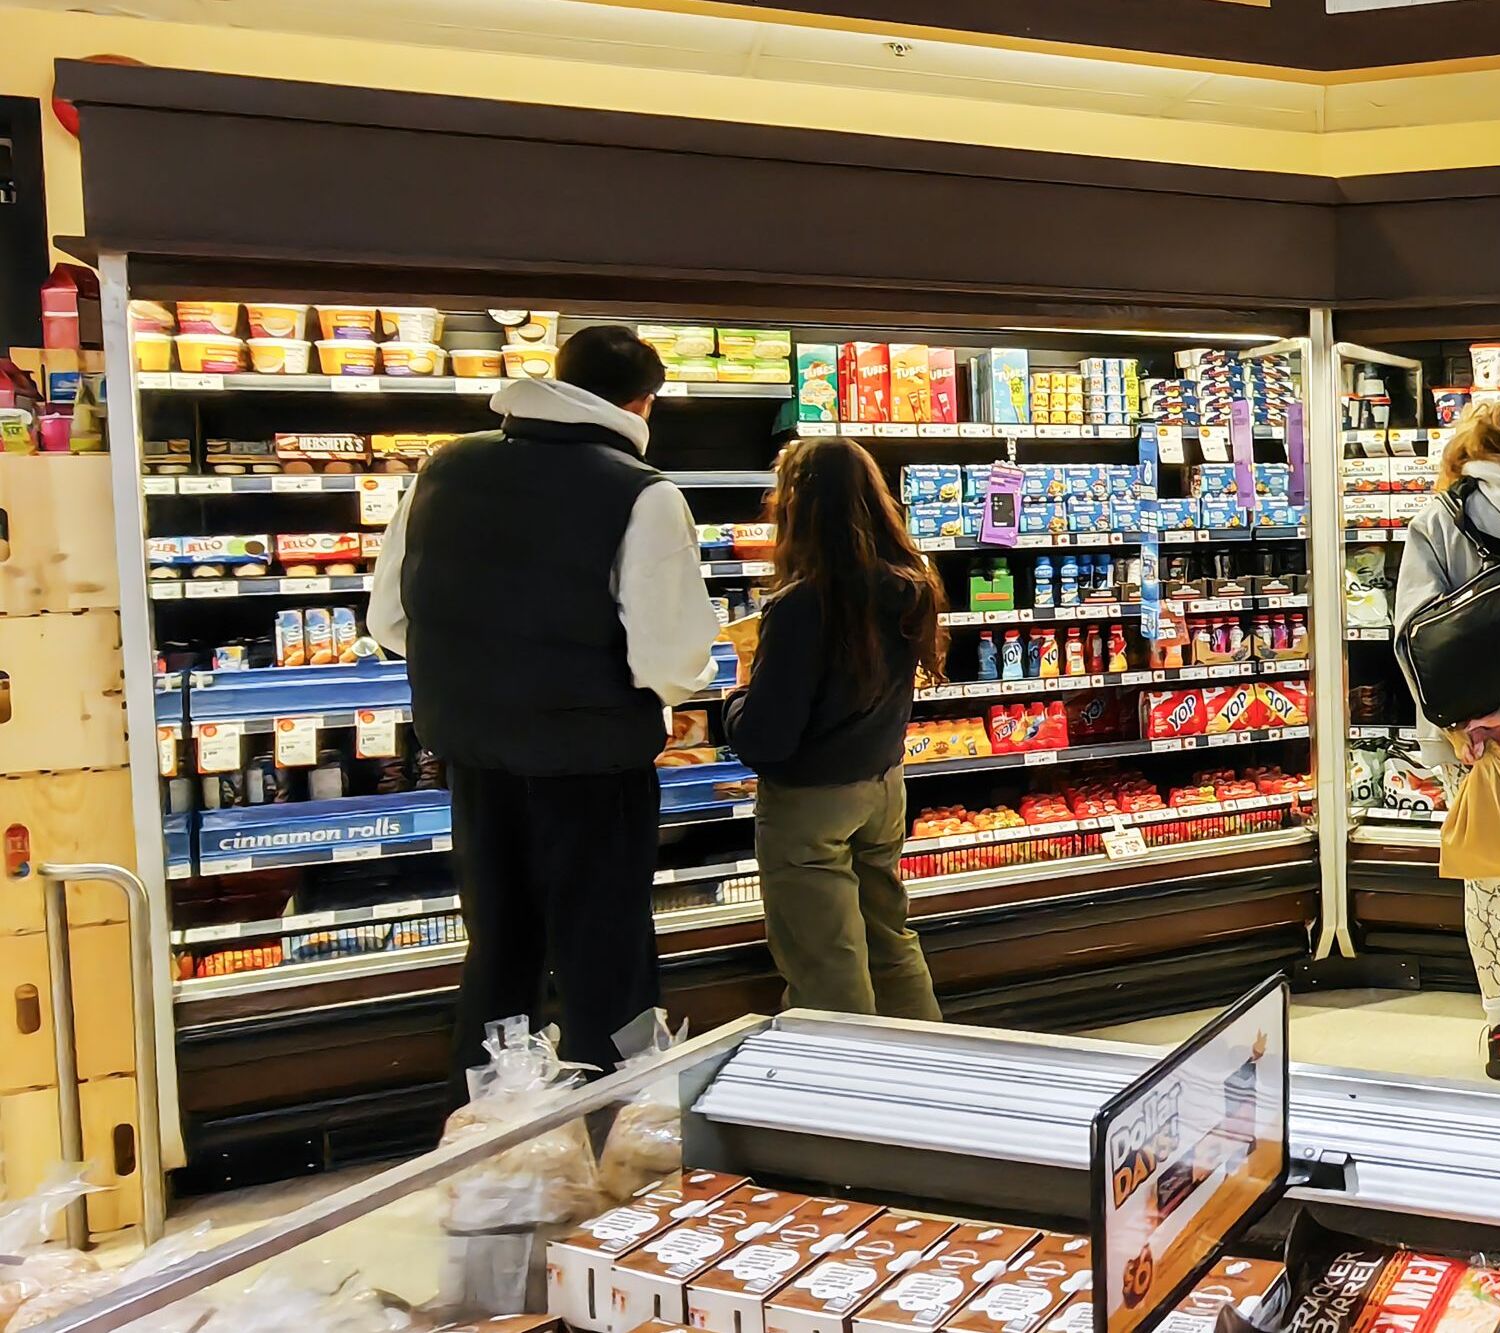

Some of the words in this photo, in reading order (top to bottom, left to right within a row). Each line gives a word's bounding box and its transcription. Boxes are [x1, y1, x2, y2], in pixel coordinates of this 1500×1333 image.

[858, 364, 888, 379] TUBES
[896, 365, 927, 379] TUBES
[930, 368, 953, 381] UBES
[1168, 694, 1197, 731] YOP
[1222, 691, 1247, 725] YOP
[995, 719, 1018, 740] YOP
[907, 736, 930, 757] YOP
[219, 831, 342, 851] cinnamon
[348, 817, 400, 839] rolls
[1312, 1255, 1385, 1333] BARREL
[1383, 1254, 1452, 1311] MEX
